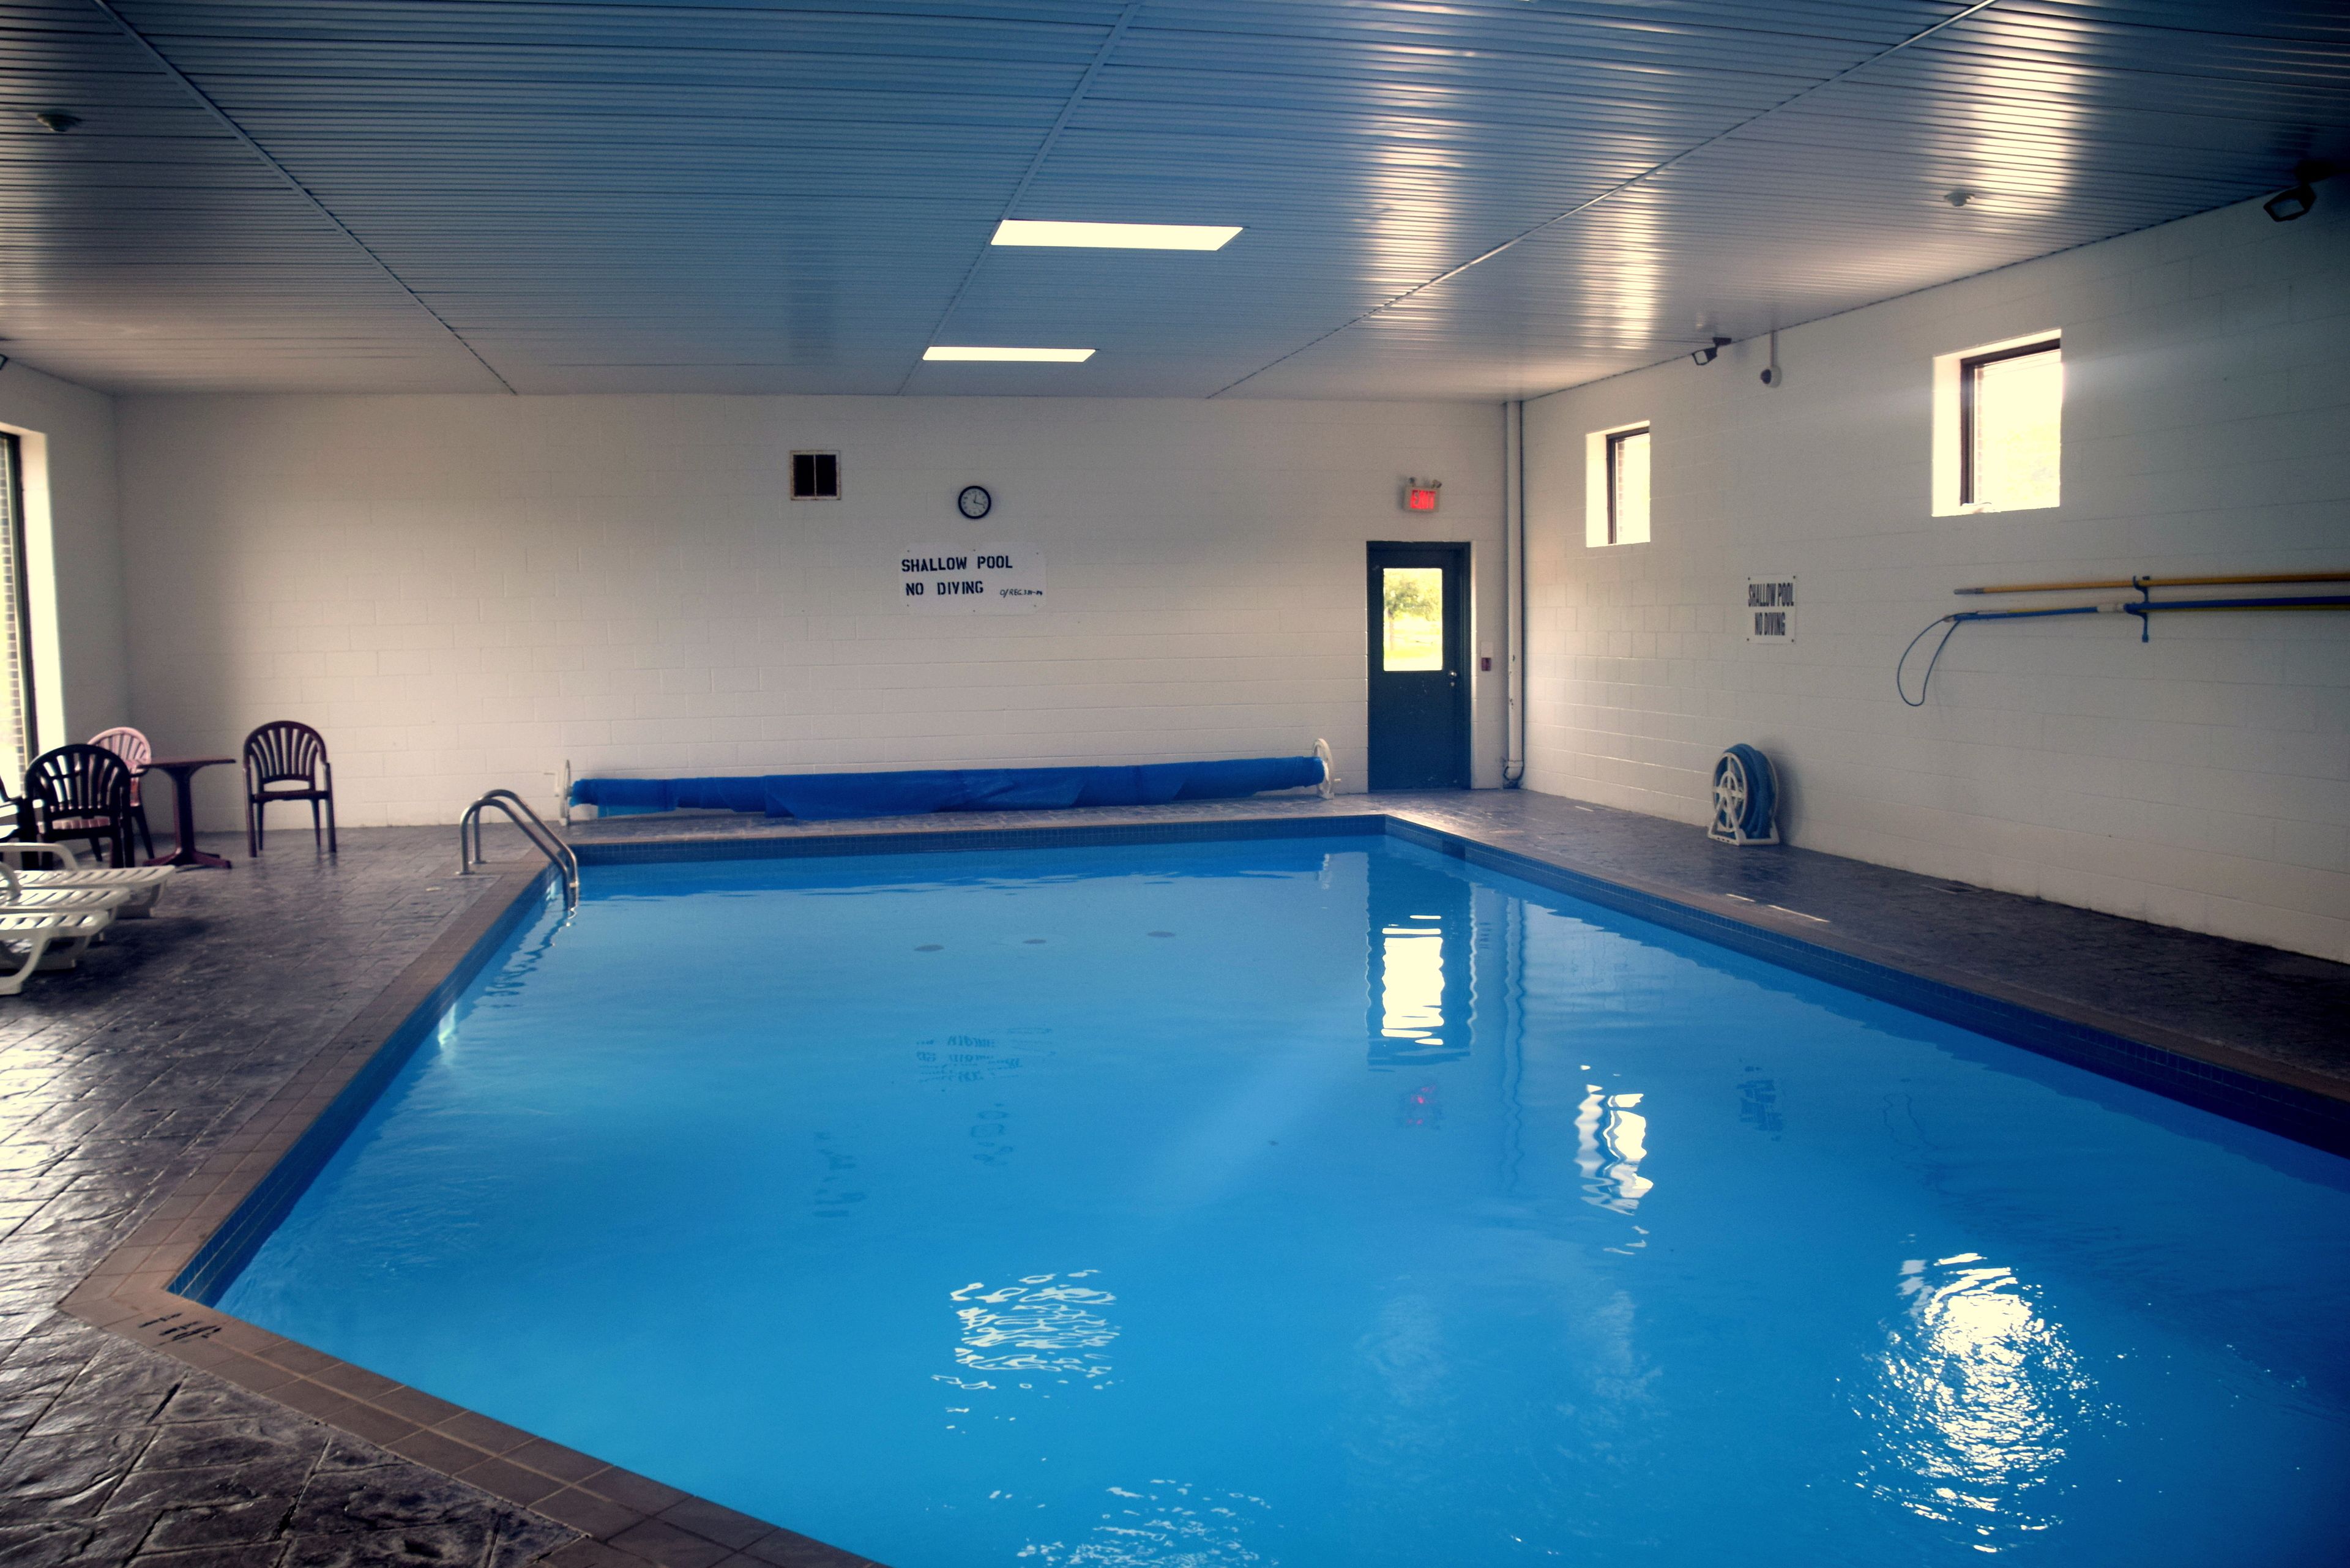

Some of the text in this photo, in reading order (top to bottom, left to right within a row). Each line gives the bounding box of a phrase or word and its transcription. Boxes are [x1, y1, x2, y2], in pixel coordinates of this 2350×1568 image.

[901, 555, 1013, 572] SHALLOW POOL
[905, 581, 984, 596] NO DIVING
[1748, 582, 1794, 607] SHALLOW POOL
[1755, 612, 1786, 635] NO DIVING
